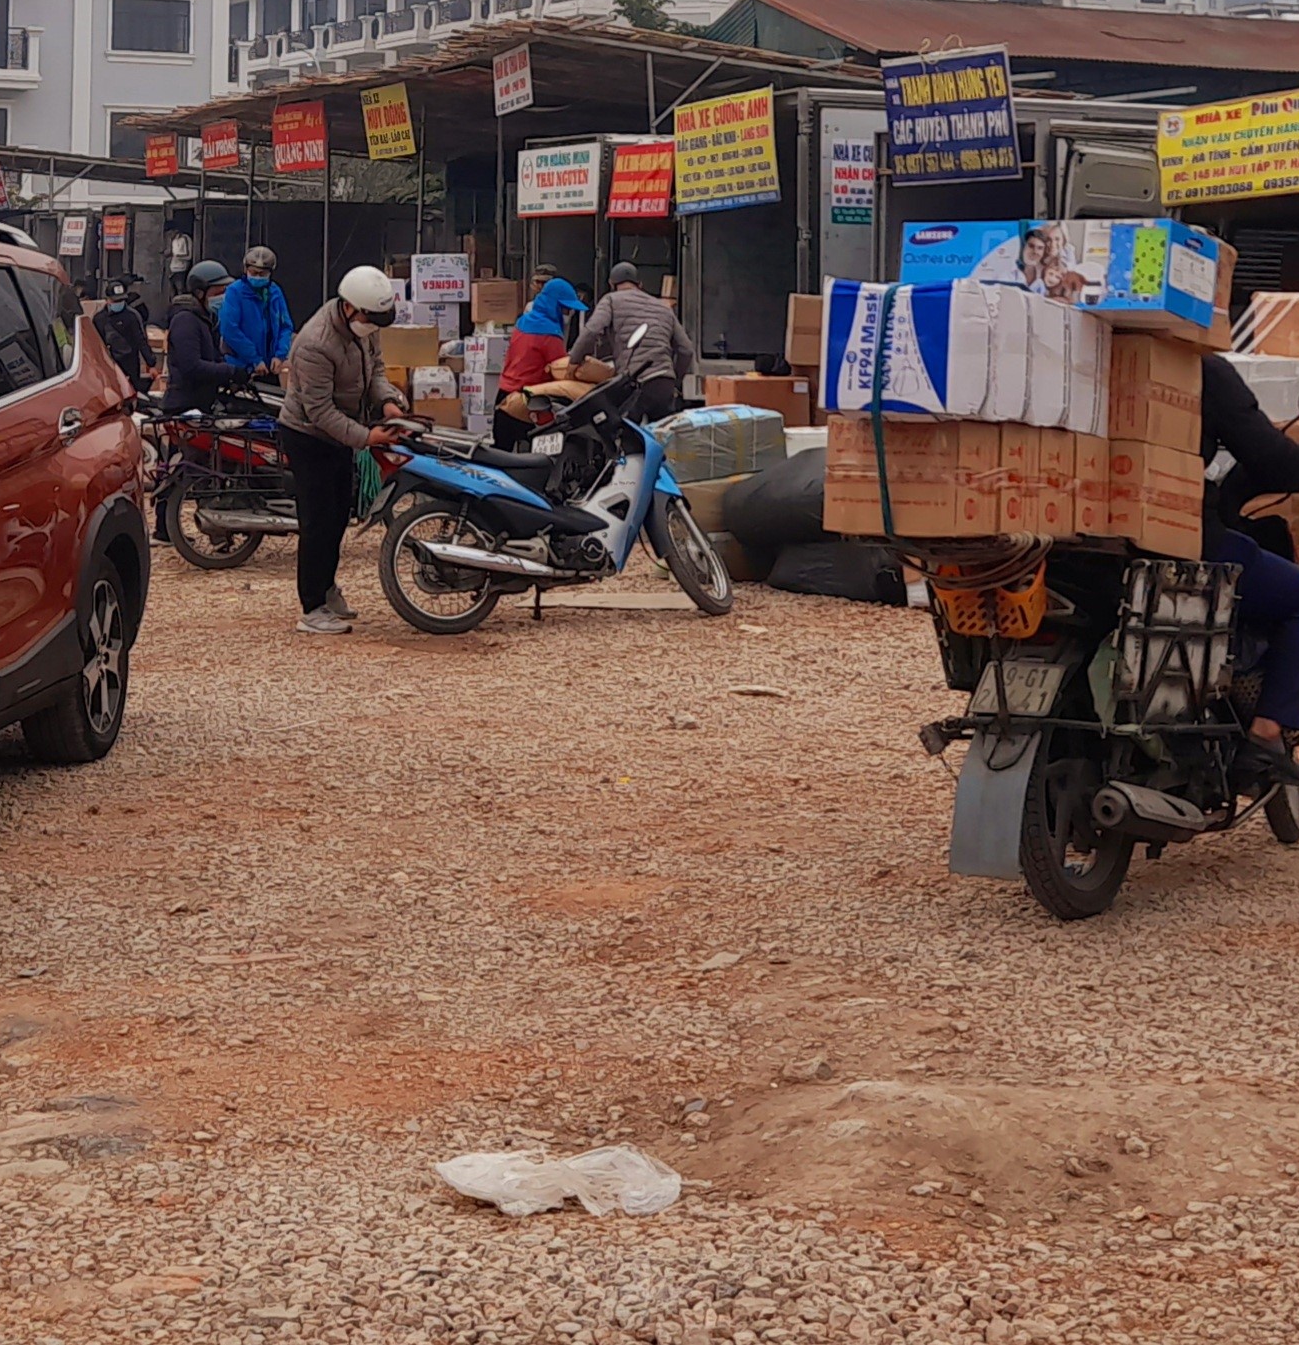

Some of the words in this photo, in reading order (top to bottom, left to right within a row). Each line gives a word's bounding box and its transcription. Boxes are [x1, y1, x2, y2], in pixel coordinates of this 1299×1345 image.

[698, 108, 710, 129] XE
[747, 96, 769, 119] ANH
[1225, 107, 1242, 121] XE
[861, 292, 879, 344] Mask
[858, 348, 874, 390] KF94
[1004, 667, 1049, 688] 9-G1
